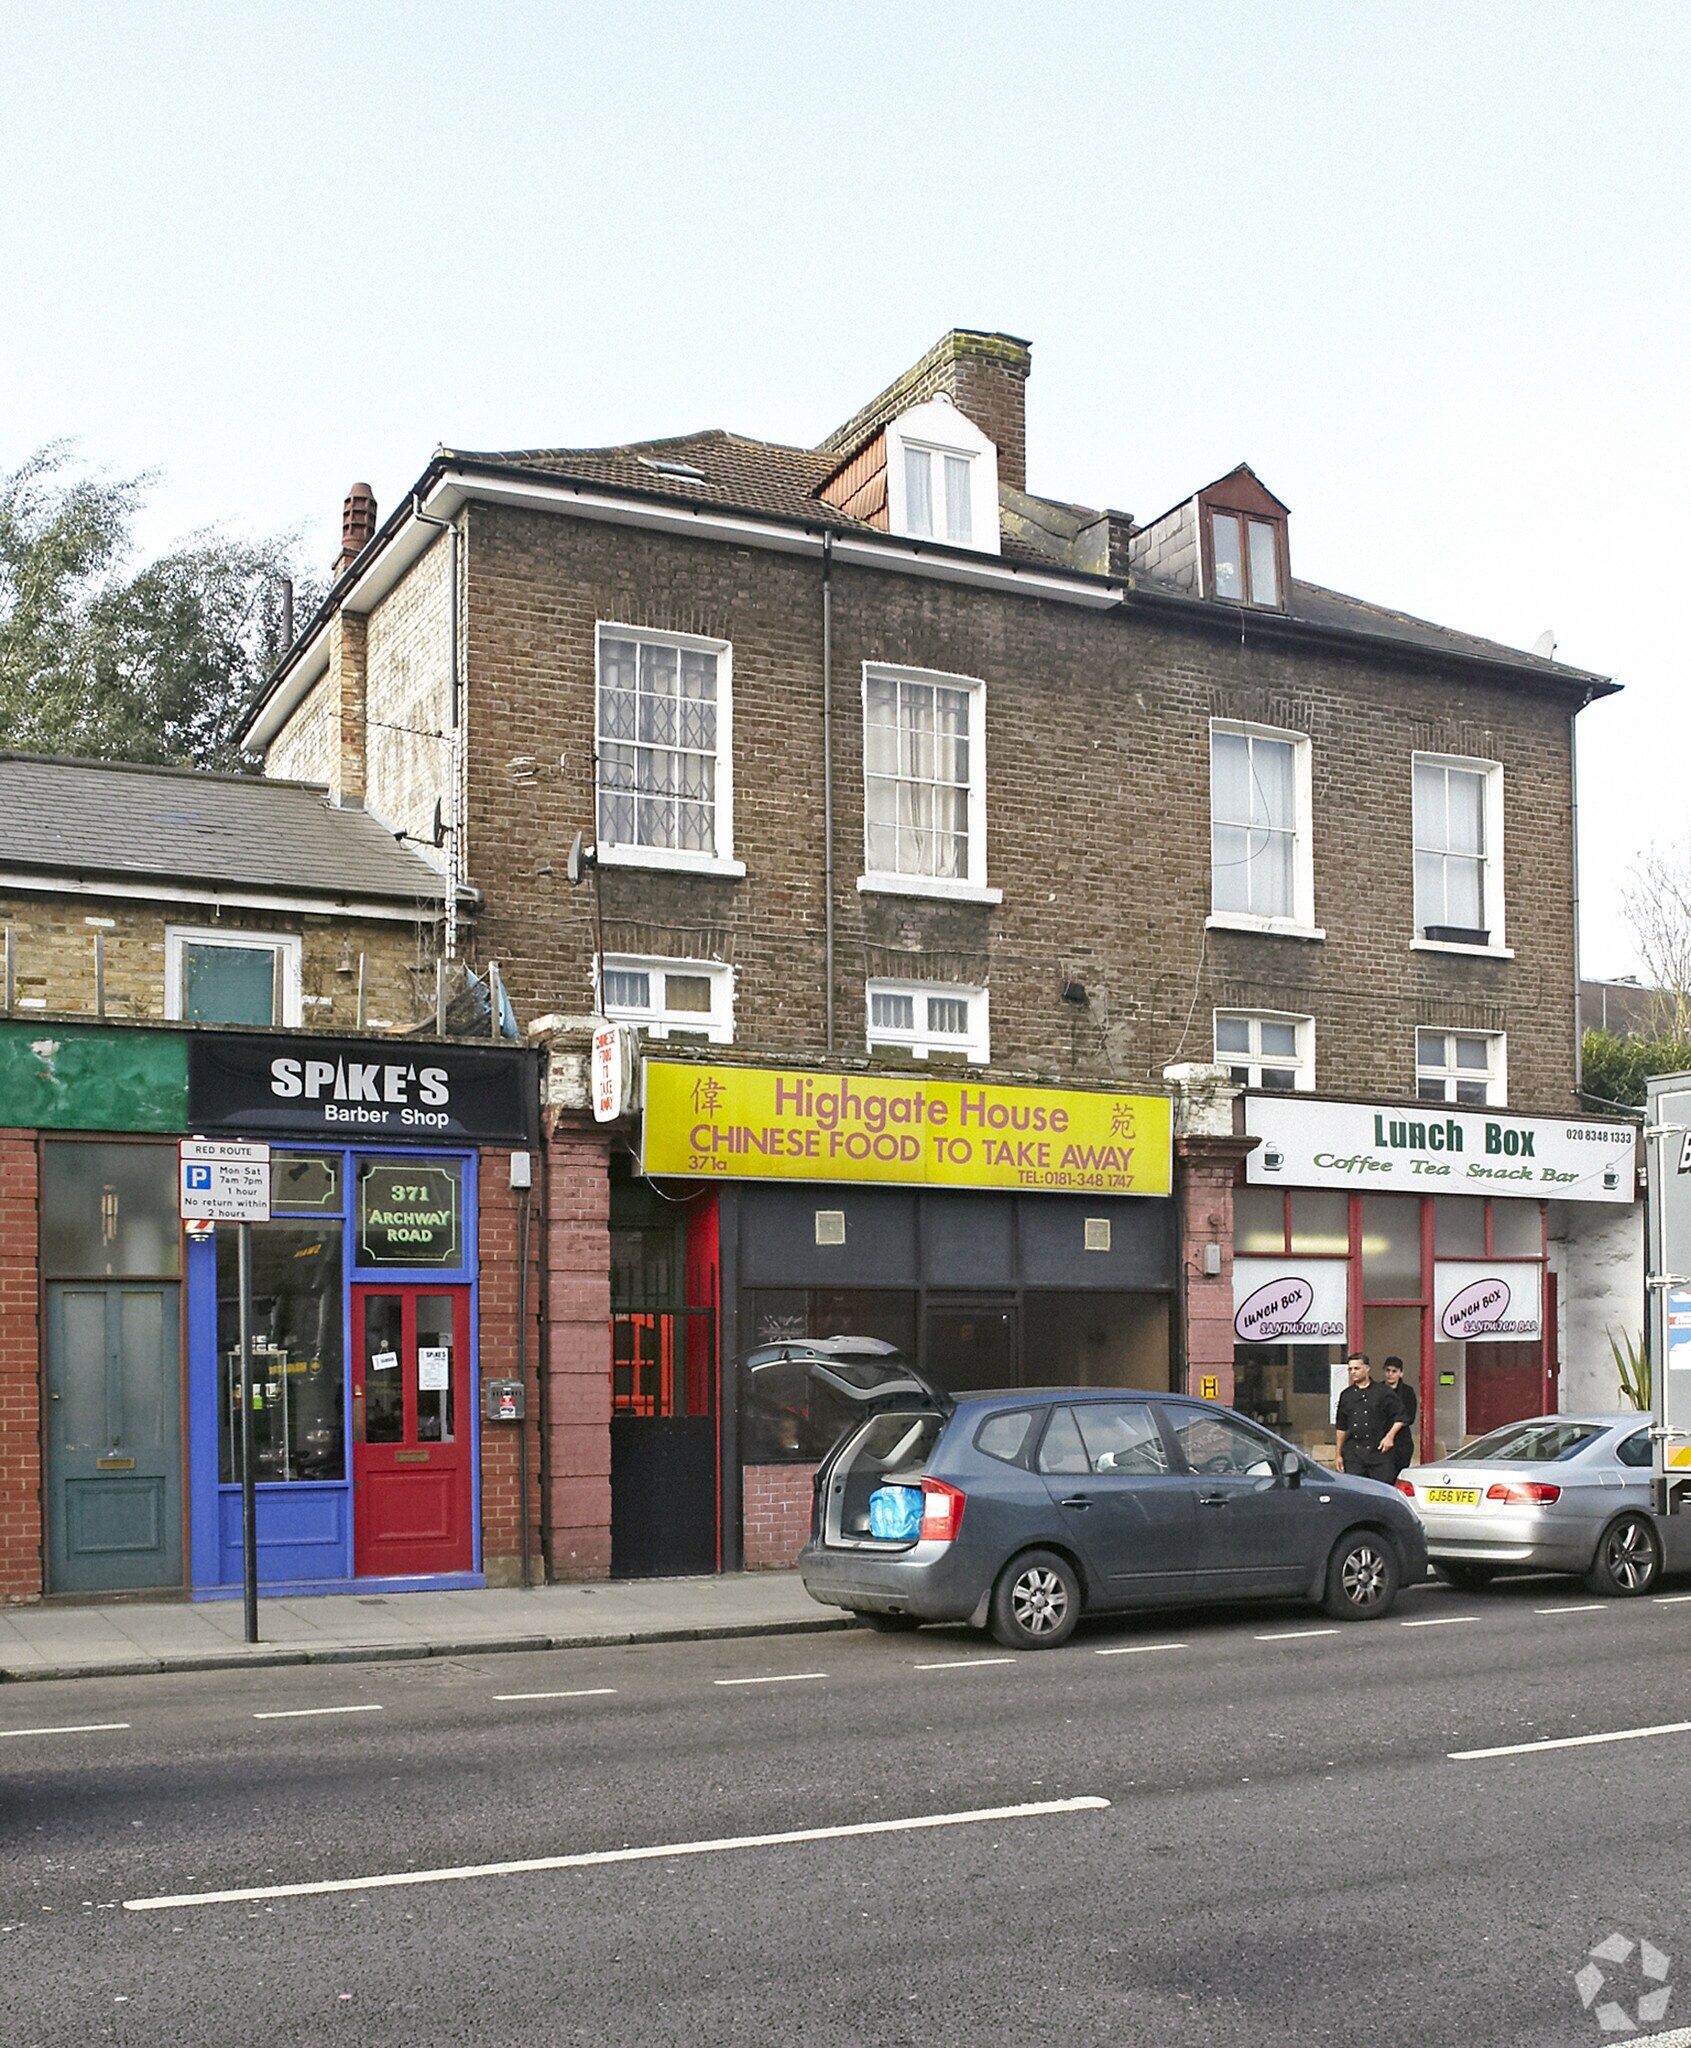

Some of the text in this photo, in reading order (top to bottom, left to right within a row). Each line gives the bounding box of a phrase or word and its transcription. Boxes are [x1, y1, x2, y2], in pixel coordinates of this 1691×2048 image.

[271, 1054, 449, 1106] SPIKE'S
[690, 1076, 726, 1119] 偉
[776, 1077, 1069, 1133] Highgate House
[324, 1104, 449, 1129] Barber Shop
[1109, 1102, 1136, 1140] 苑
[1374, 1114, 1536, 1157] Lunch Box
[1566, 1128, 1632, 1144] 020 8348 1333
[195, 1146, 252, 1156] RED ROUTE
[690, 1124, 1135, 1172] CHINESE FOOD TO TAKE AWAY
[688, 1155, 727, 1170] 371a
[1313, 1153, 1580, 1183] Coffee Tea Snack Bar
[192, 1168, 207, 1187] P
[1018, 1170, 1135, 1188] TEL:0181-348 1747
[236, 1188, 257, 1196] hour
[391, 1185, 430, 1202] 371
[184, 1198, 267, 1208] No return within
[208, 1208, 246, 1218] 2 hours
[368, 1209, 451, 1226] ARCHWAY
[387, 1228, 433, 1243] ROAD
[1244, 1289, 1303, 1328] LUNCH BOX
[1449, 1289, 1501, 1326] LUNCH BOX
[1260, 1322, 1344, 1336] SANDWICH BAR
[1463, 1320, 1538, 1333] SANDWICH BAR
[1429, 1490, 1453, 1502] GJ56
